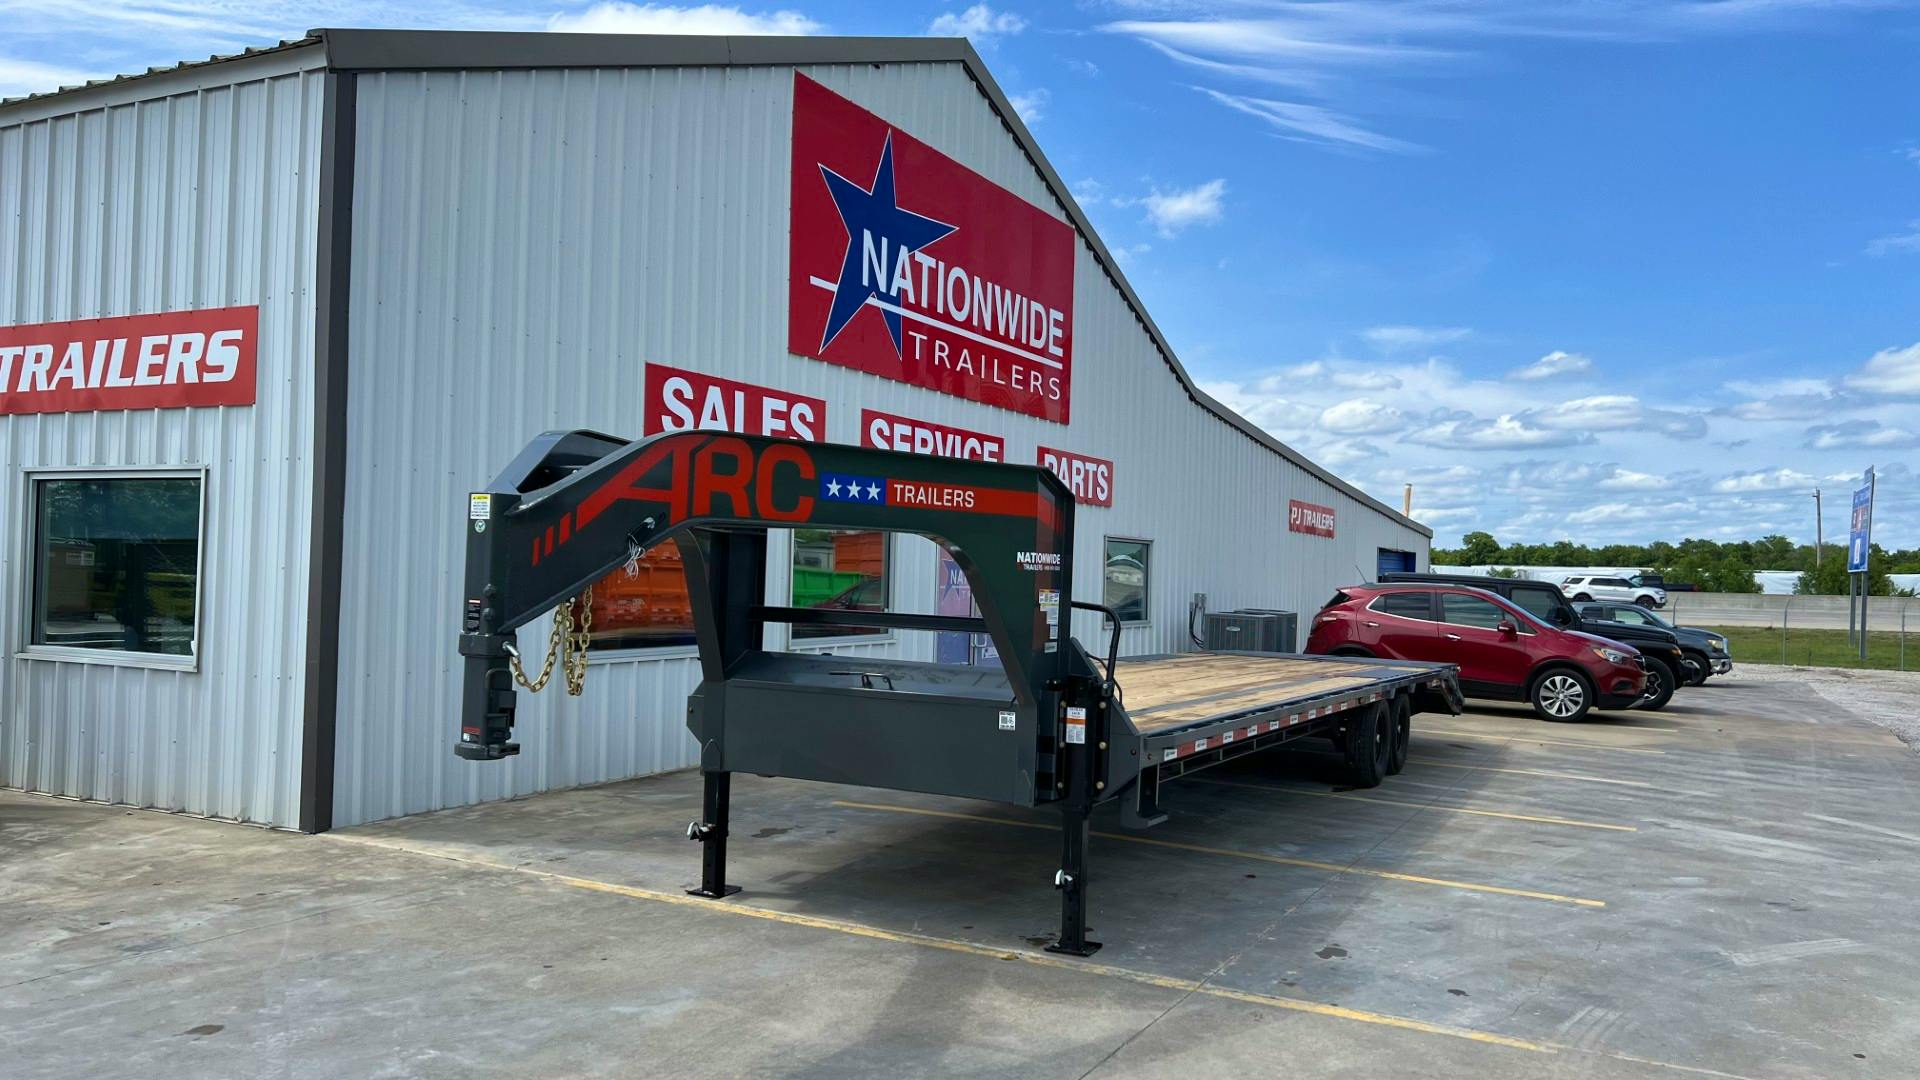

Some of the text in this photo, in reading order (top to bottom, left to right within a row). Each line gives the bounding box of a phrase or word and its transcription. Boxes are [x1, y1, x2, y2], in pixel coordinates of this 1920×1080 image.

[862, 228, 1064, 357] NATIONWIDE
[0, 329, 244, 394] TRAILERS
[908, 330, 1061, 401] TRAILERS
[576, 434, 816, 526] ARC
[893, 483, 975, 508] TRAILERS
[1290, 506, 1335, 531] PJ TRAILERS
[1016, 551, 1061, 565] NATIONWIDE
